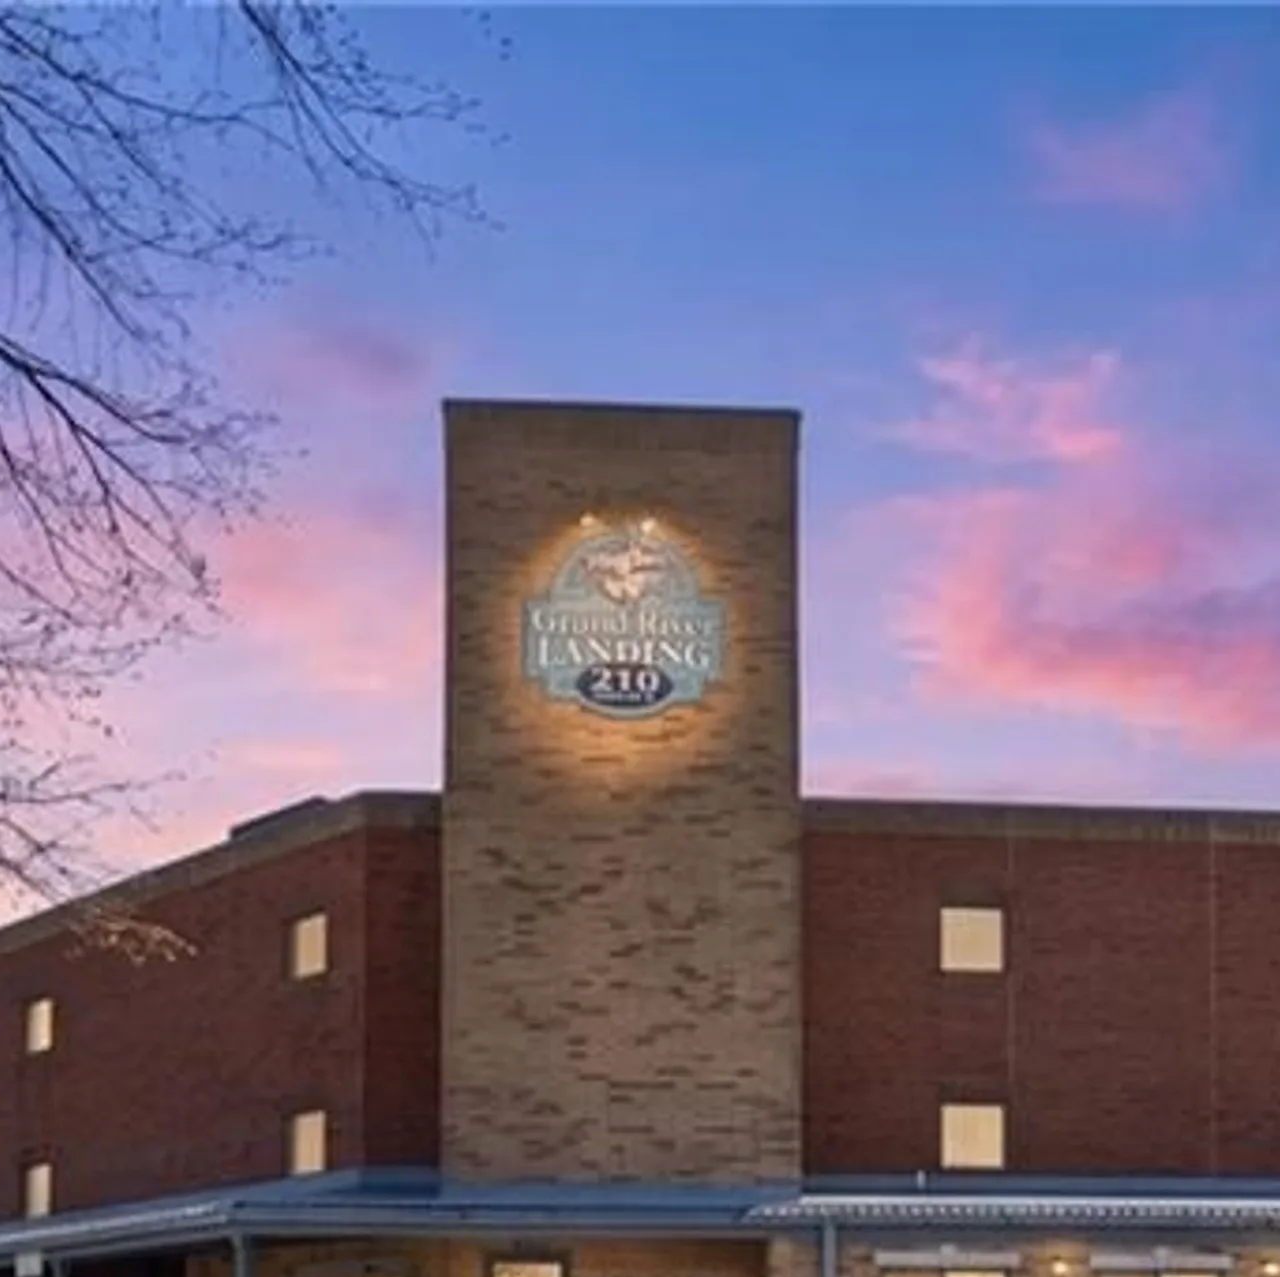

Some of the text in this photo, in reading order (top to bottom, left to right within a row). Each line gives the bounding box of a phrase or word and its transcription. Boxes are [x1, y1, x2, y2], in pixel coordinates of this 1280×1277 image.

[639, 609, 714, 638] River
[537, 636, 711, 668] LANDING
[590, 668, 661, 692] 210
